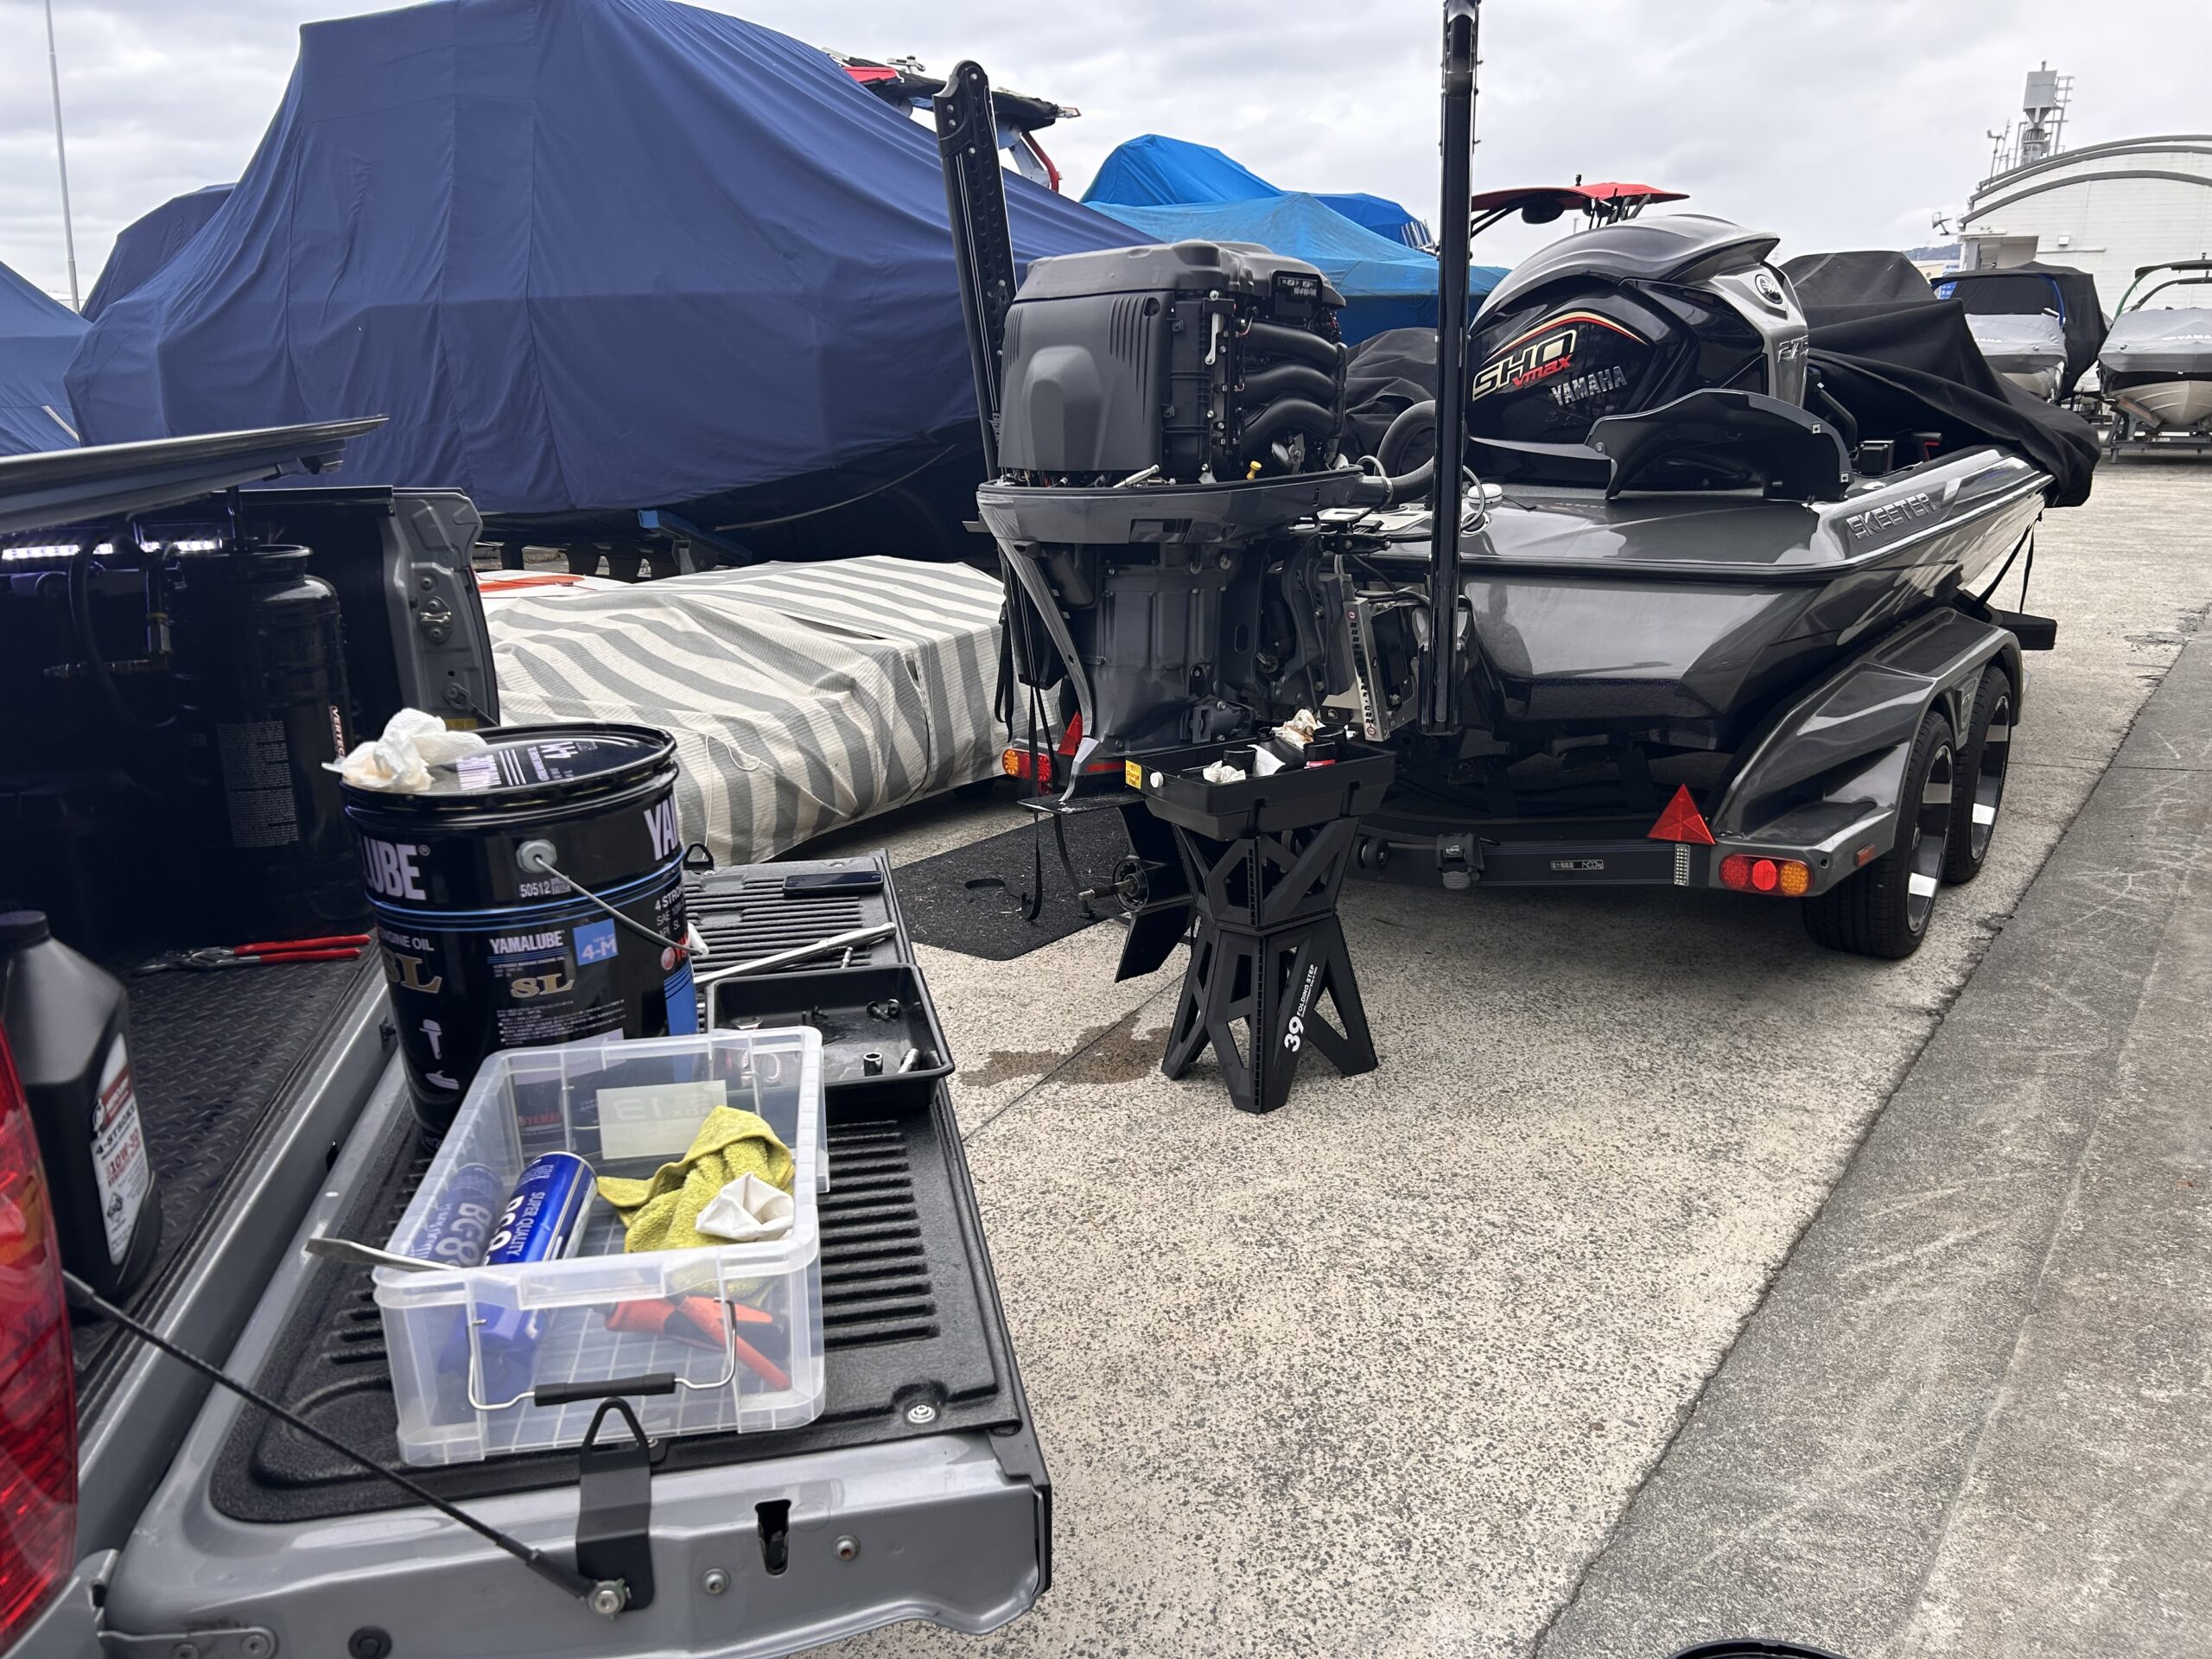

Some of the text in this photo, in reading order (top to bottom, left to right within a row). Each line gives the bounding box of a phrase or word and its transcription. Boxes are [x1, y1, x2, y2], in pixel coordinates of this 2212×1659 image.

[1472, 329, 1578, 402] SHO
[1550, 365, 1628, 406] YAMAHA
[1846, 493, 1937, 540] SKEETER
[518, 880, 551, 898] 50512
[654, 899, 662, 911] 4
[657, 910, 671, 926] SAE
[411, 937, 435, 951] OIL
[489, 931, 564, 955] YAMALUBE
[582, 938, 618, 960] 4-M
[510, 973, 575, 998] SL
[1296, 984, 1310, 1017] FOLDING
[1306, 963, 1314, 983] STEP
[1284, 1015, 1304, 1052] 39
[506, 1217, 534, 1255] QUALITY
